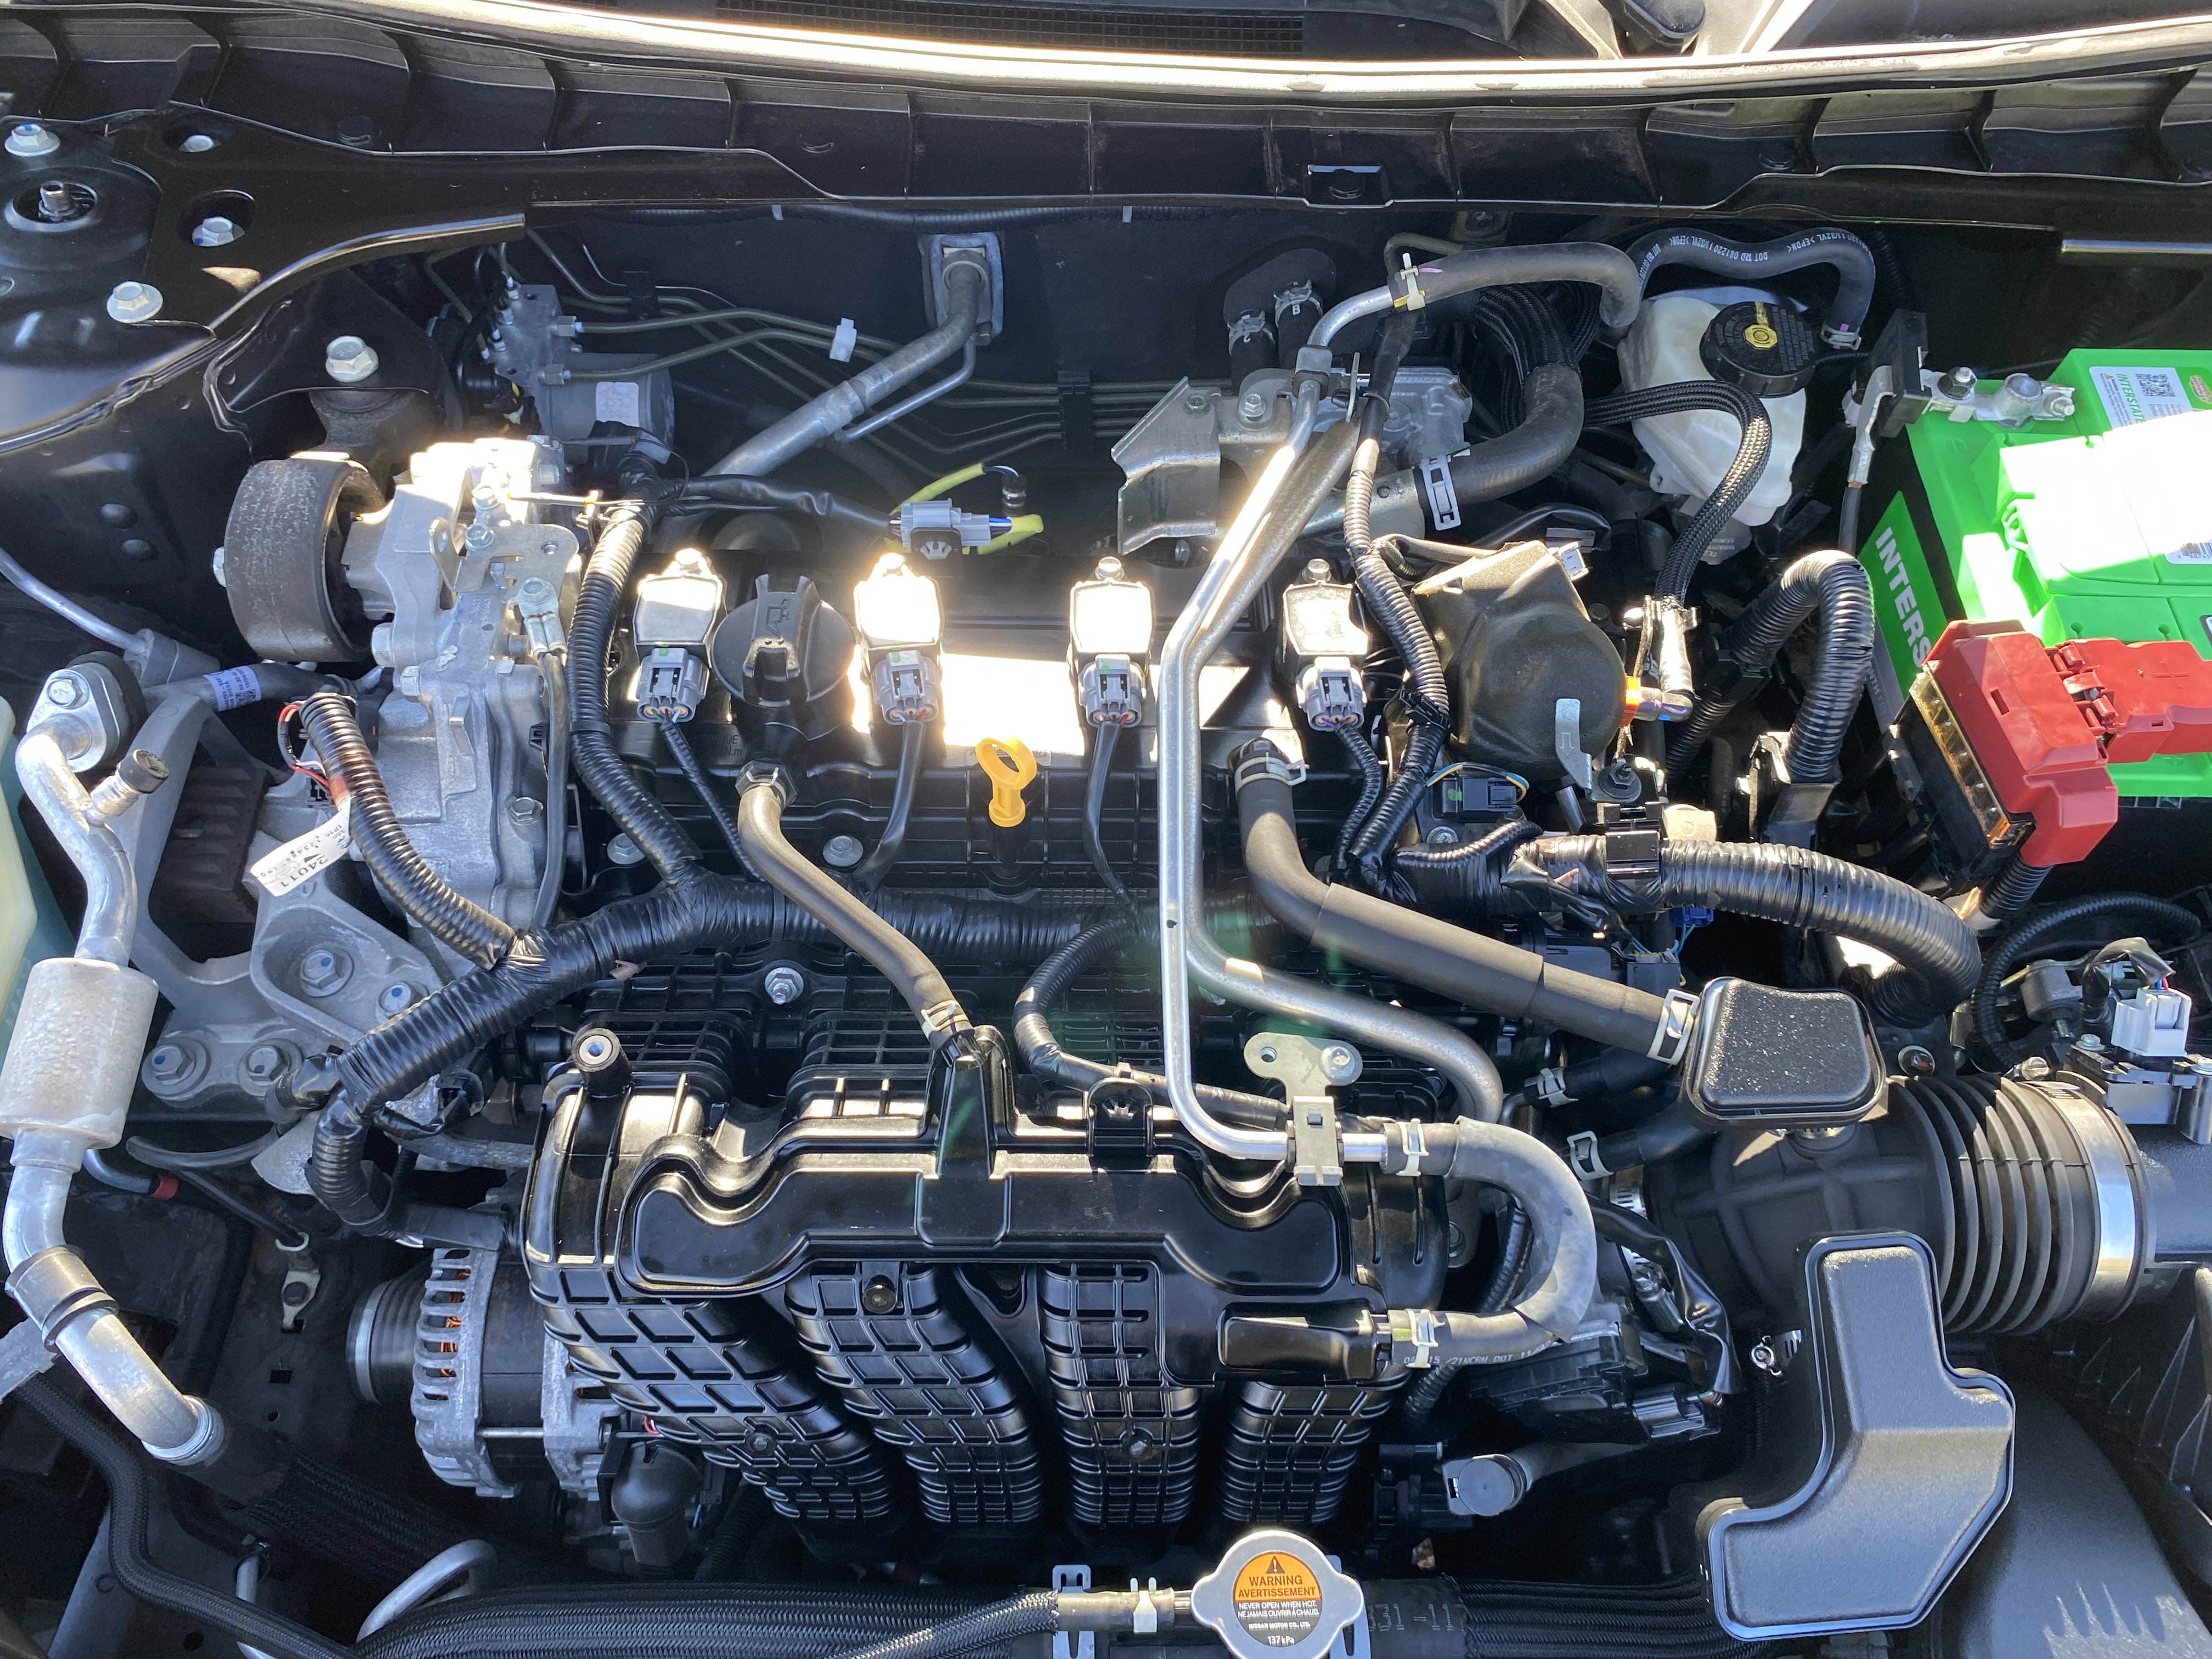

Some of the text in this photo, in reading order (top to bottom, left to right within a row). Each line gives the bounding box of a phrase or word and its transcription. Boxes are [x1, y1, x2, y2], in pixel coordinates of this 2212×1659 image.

[1754, 251, 1769, 262] DOT
[1875, 526, 1932, 668] INTERS
[1249, 1575, 1303, 1587] WARNING
[1238, 1587, 1316, 1598] AVERTISSEMENT
